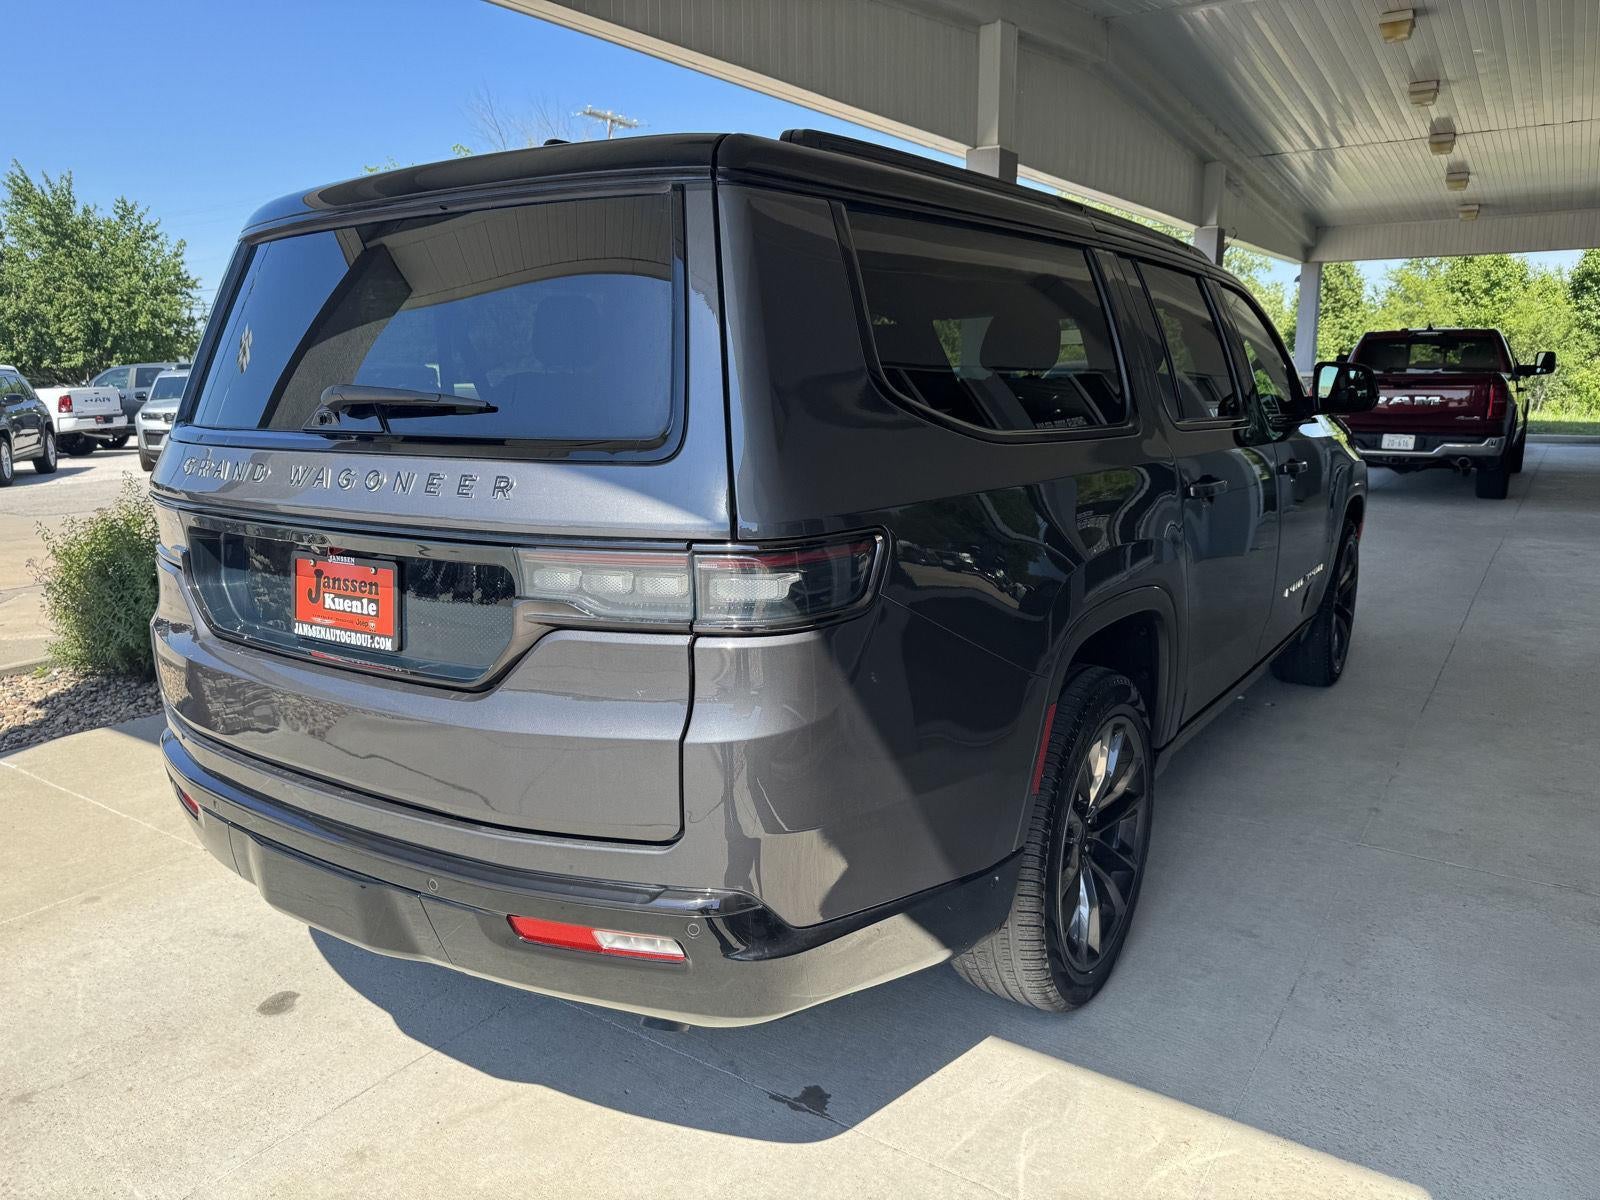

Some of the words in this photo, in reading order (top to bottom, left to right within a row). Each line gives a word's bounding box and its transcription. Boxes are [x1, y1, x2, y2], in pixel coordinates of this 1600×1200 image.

[183, 456, 272, 483] GRAND
[289, 464, 516, 501] WAGONEER
[327, 555, 355, 565] JANSSEN
[307, 568, 380, 605] Janssen
[323, 592, 377, 616] Kuenle
